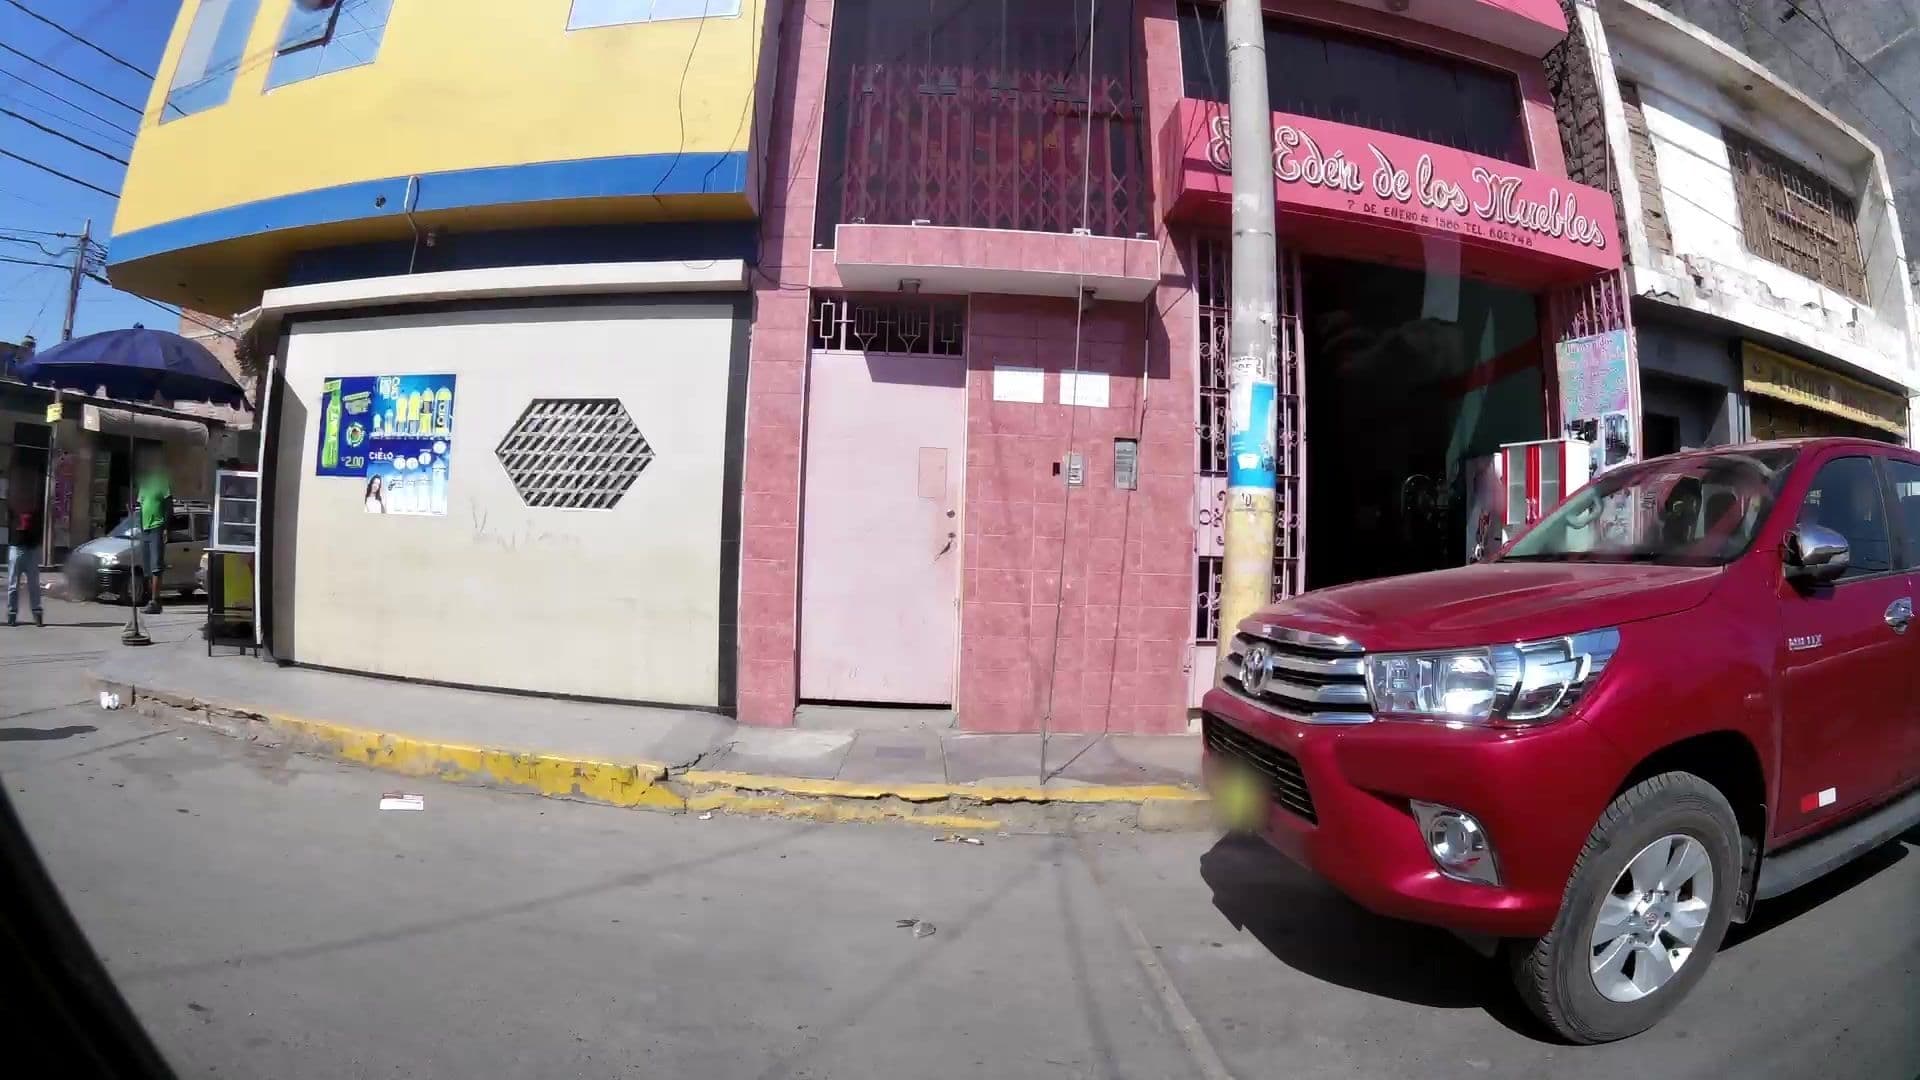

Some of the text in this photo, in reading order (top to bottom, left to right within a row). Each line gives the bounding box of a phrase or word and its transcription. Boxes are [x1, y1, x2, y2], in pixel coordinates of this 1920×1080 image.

[1273, 126, 1364, 192] Edén
[1372, 144, 1412, 201] de
[1416, 154, 1469, 214] los
[1472, 167, 1606, 249] Muebles
[1363, 203, 1377, 214] DE
[1383, 206, 1418, 222] ENERO
